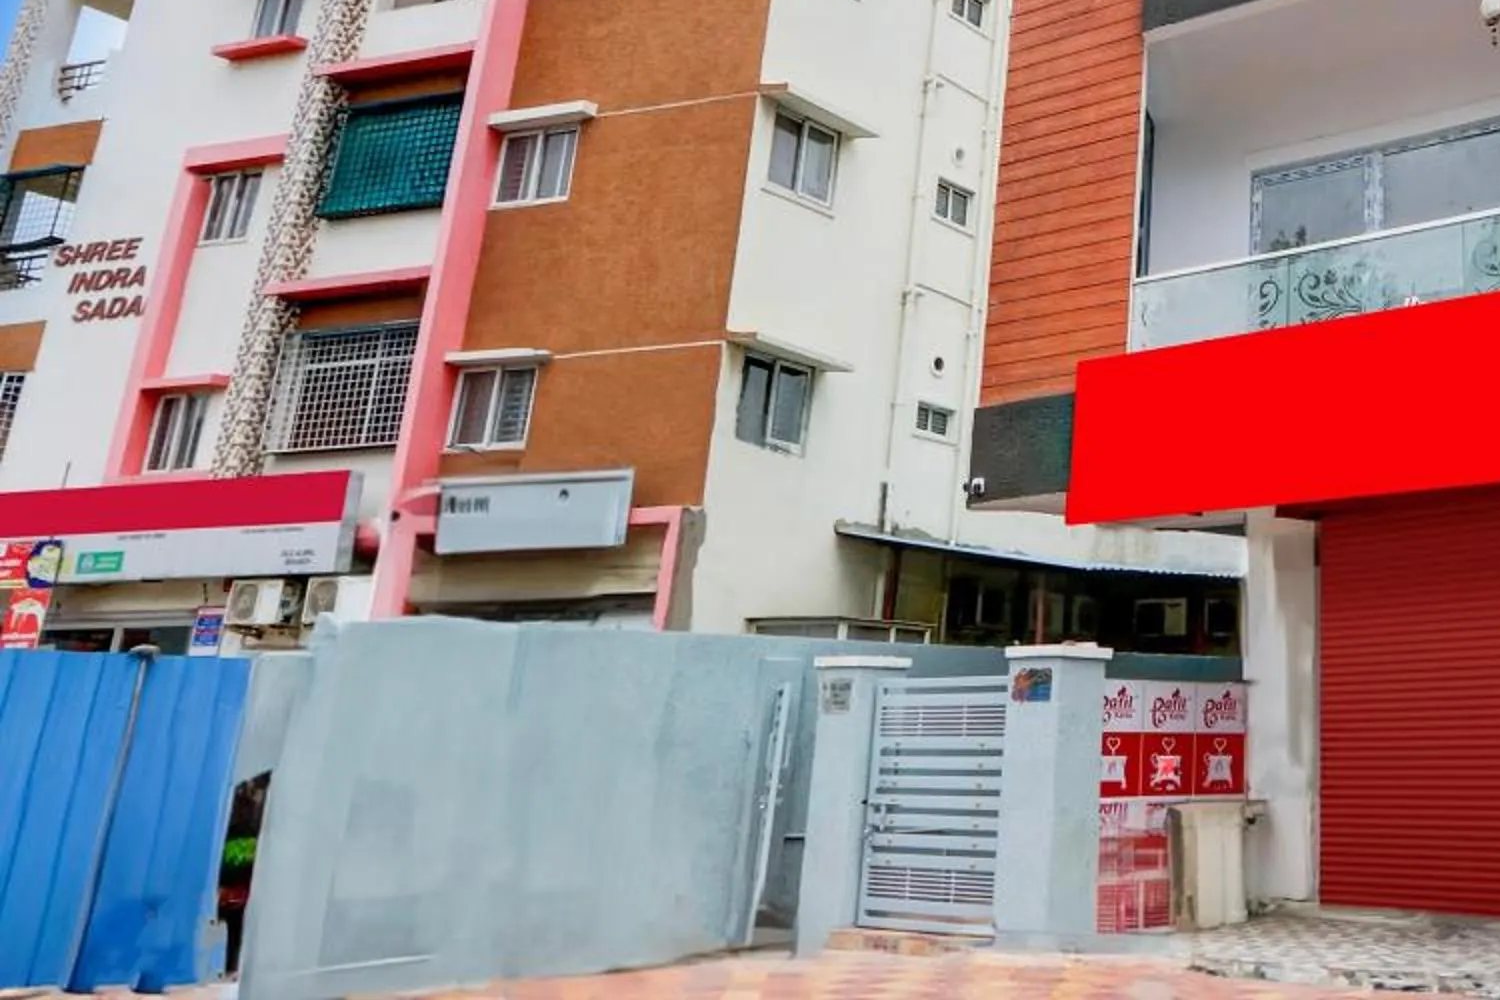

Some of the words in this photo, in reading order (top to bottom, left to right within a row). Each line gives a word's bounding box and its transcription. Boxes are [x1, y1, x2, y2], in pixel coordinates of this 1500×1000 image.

[54, 237, 144, 267] SHREE
[67, 265, 147, 294] INDRA
[72, 295, 146, 322] SADA
